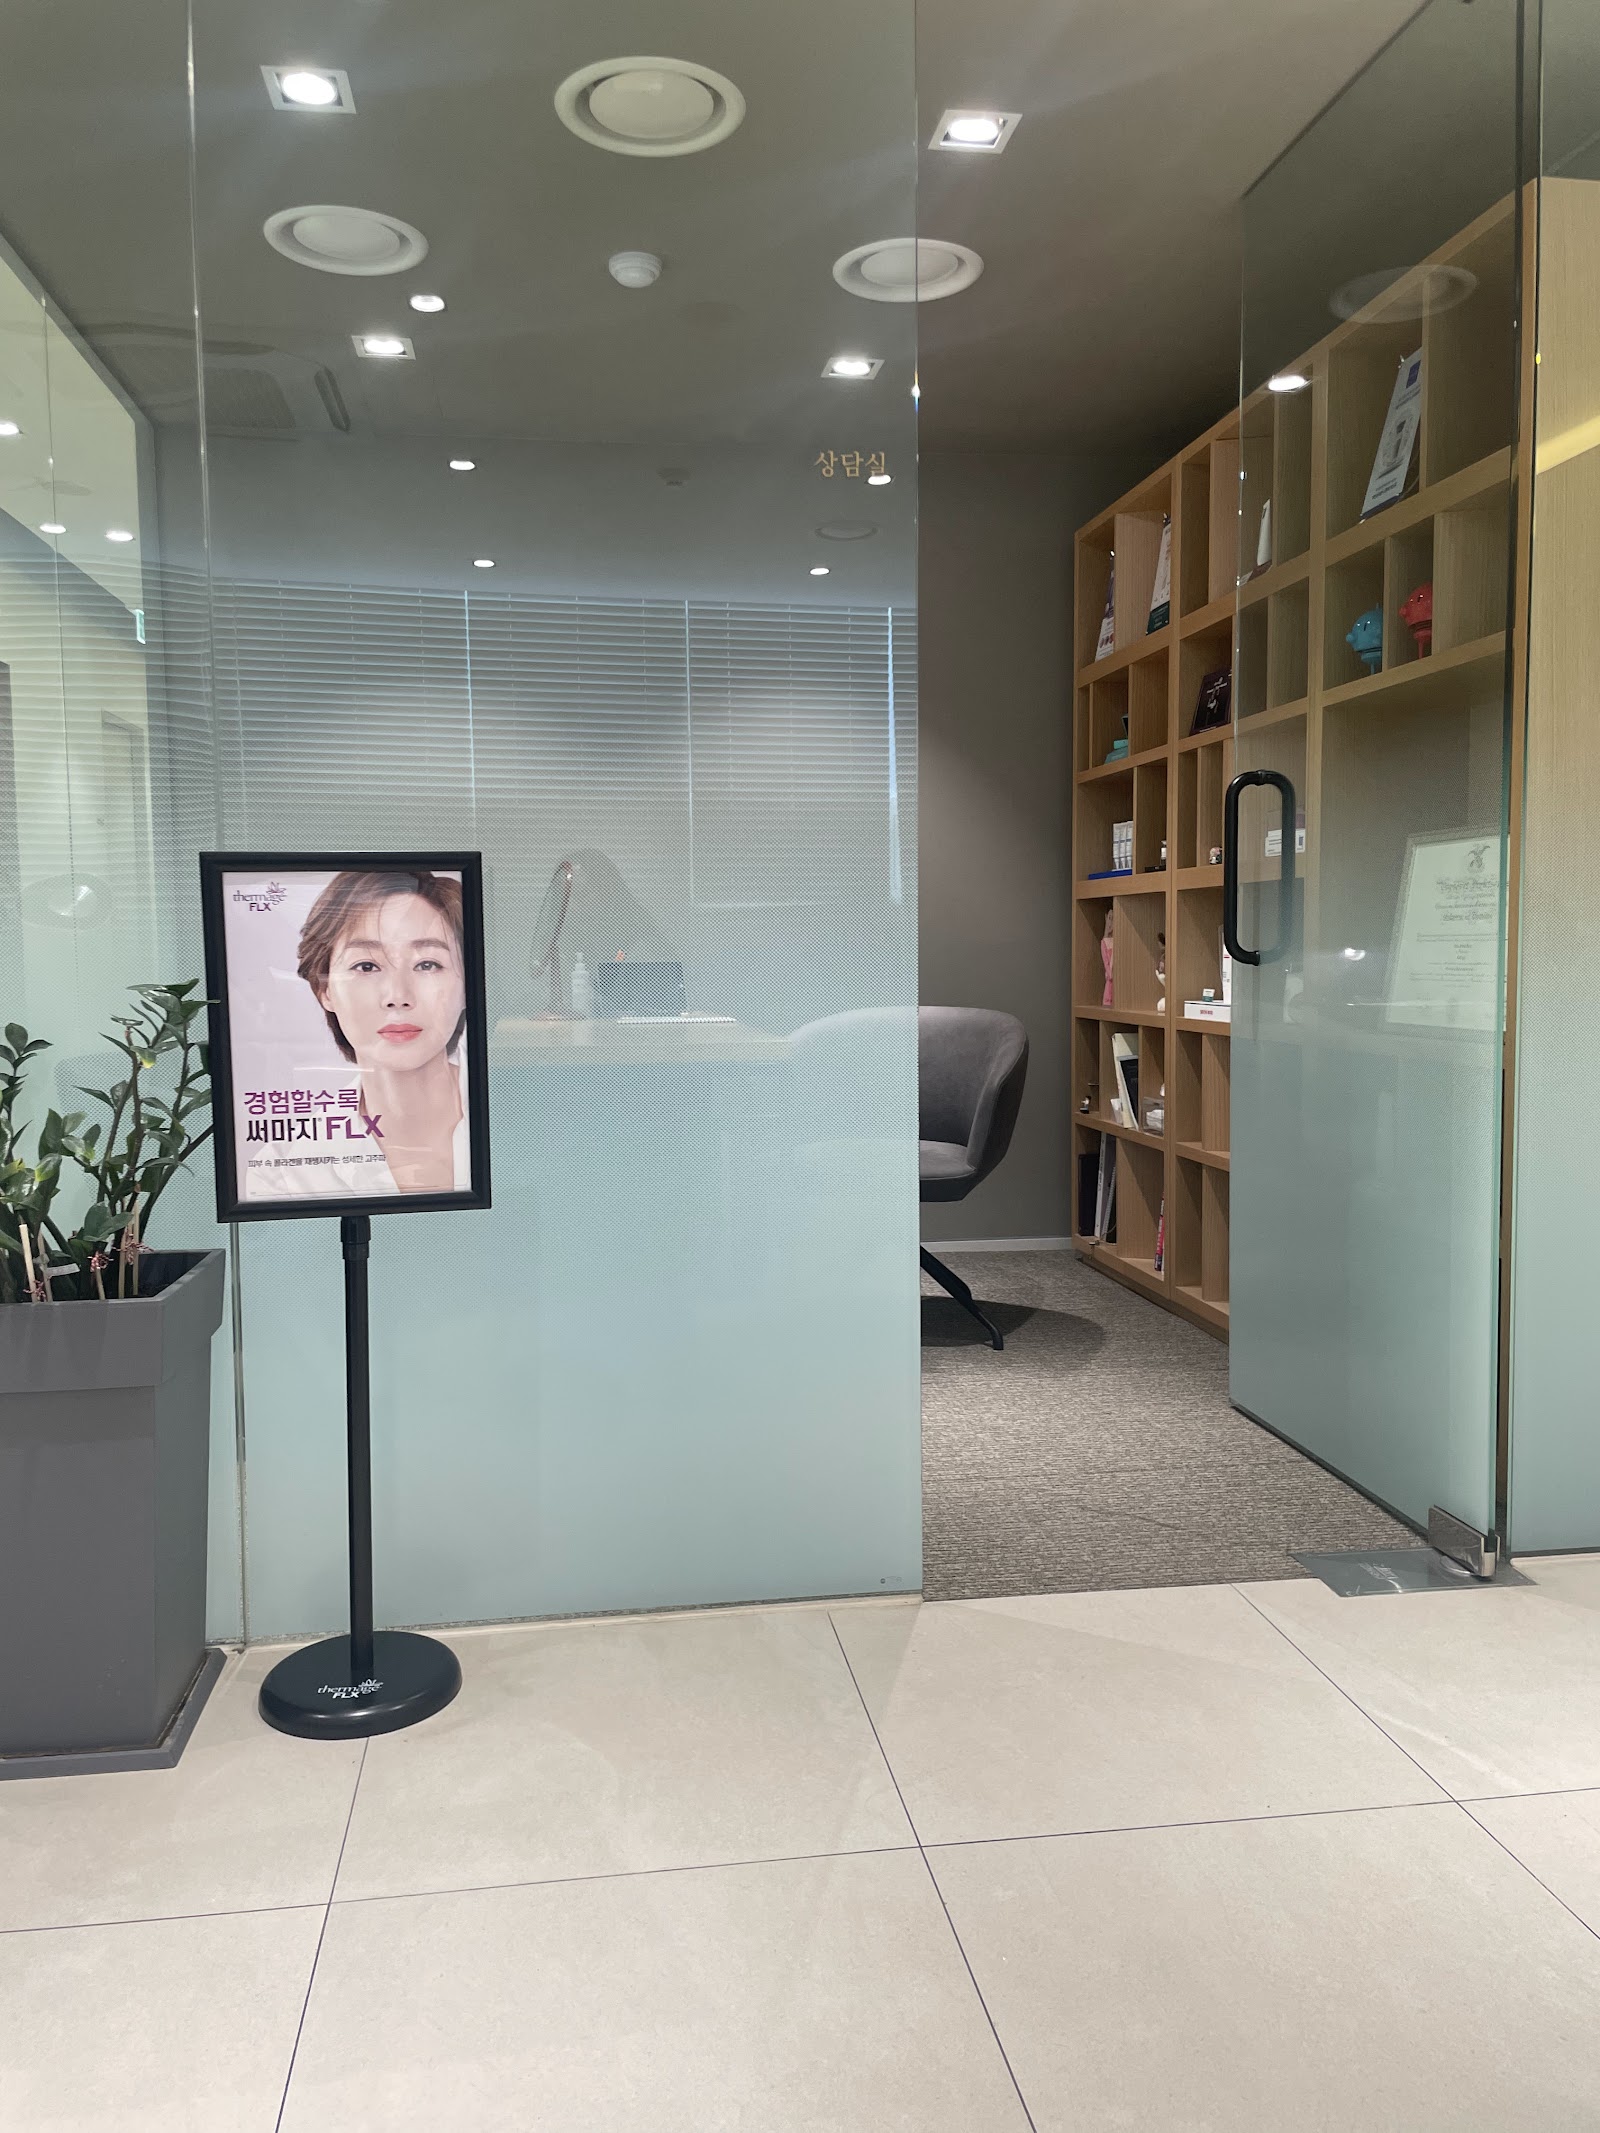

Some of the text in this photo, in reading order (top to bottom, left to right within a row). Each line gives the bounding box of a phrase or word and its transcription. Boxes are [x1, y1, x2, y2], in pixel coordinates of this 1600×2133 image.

[812, 450, 887, 478] 상담실
[248, 902, 272, 912] FLX
[243, 1088, 359, 1116] 경험할수록
[325, 1114, 385, 1140] FLX
[332, 1691, 360, 1699] FLX
